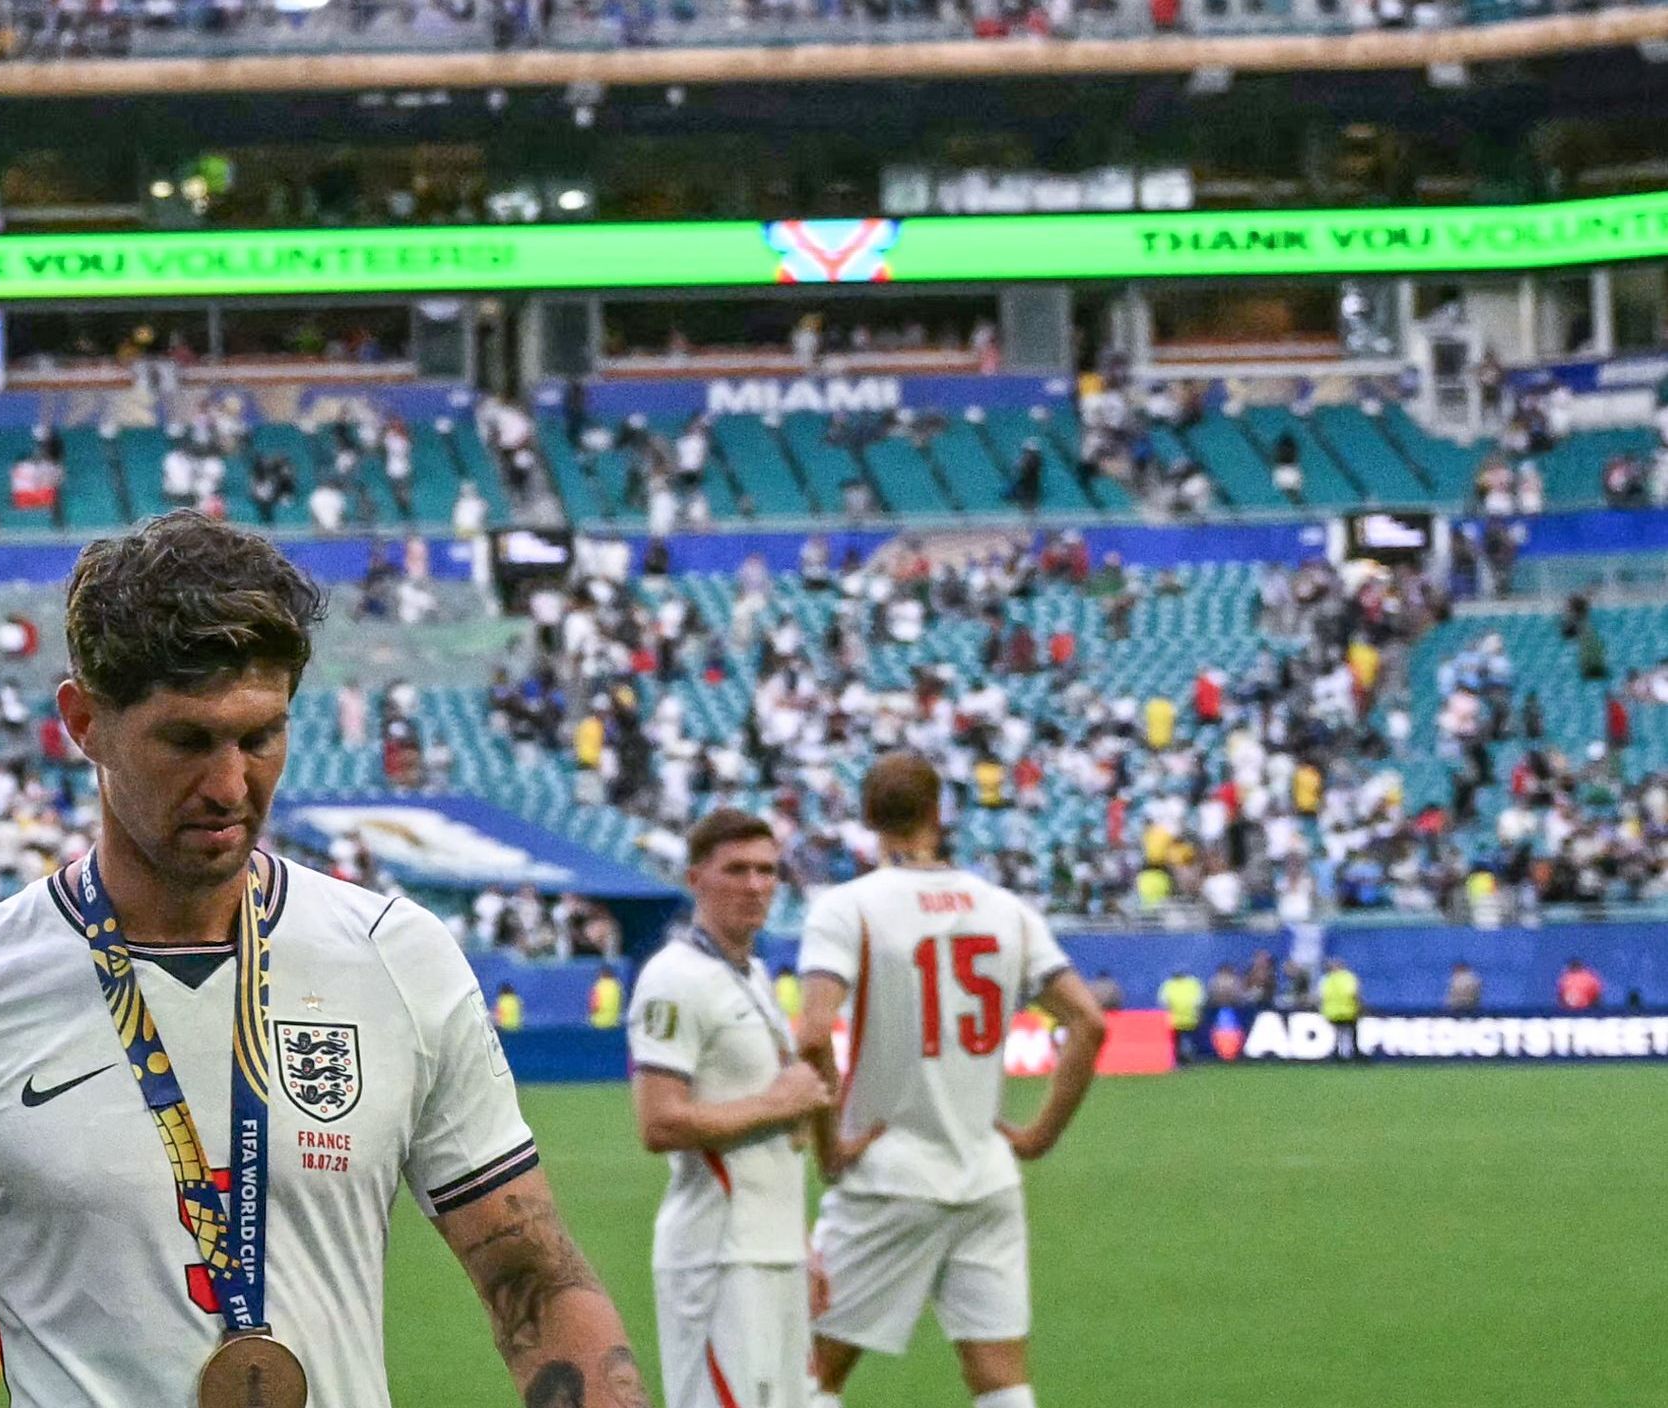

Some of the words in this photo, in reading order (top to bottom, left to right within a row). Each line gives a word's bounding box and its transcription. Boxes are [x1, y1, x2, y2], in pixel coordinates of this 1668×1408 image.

[1142, 230, 1307, 252] THANK
[1329, 227, 1432, 250] YOU
[25, 253, 127, 278] YOU
[707, 379, 900, 413] MIAMI
[914, 934, 1002, 1058] 15
[242, 1119, 257, 1162] FIFA
[298, 1130, 352, 1151] FRANCE
[301, 1153, 349, 1172] 18.07.26
[240, 1164, 258, 1241] WORLD
